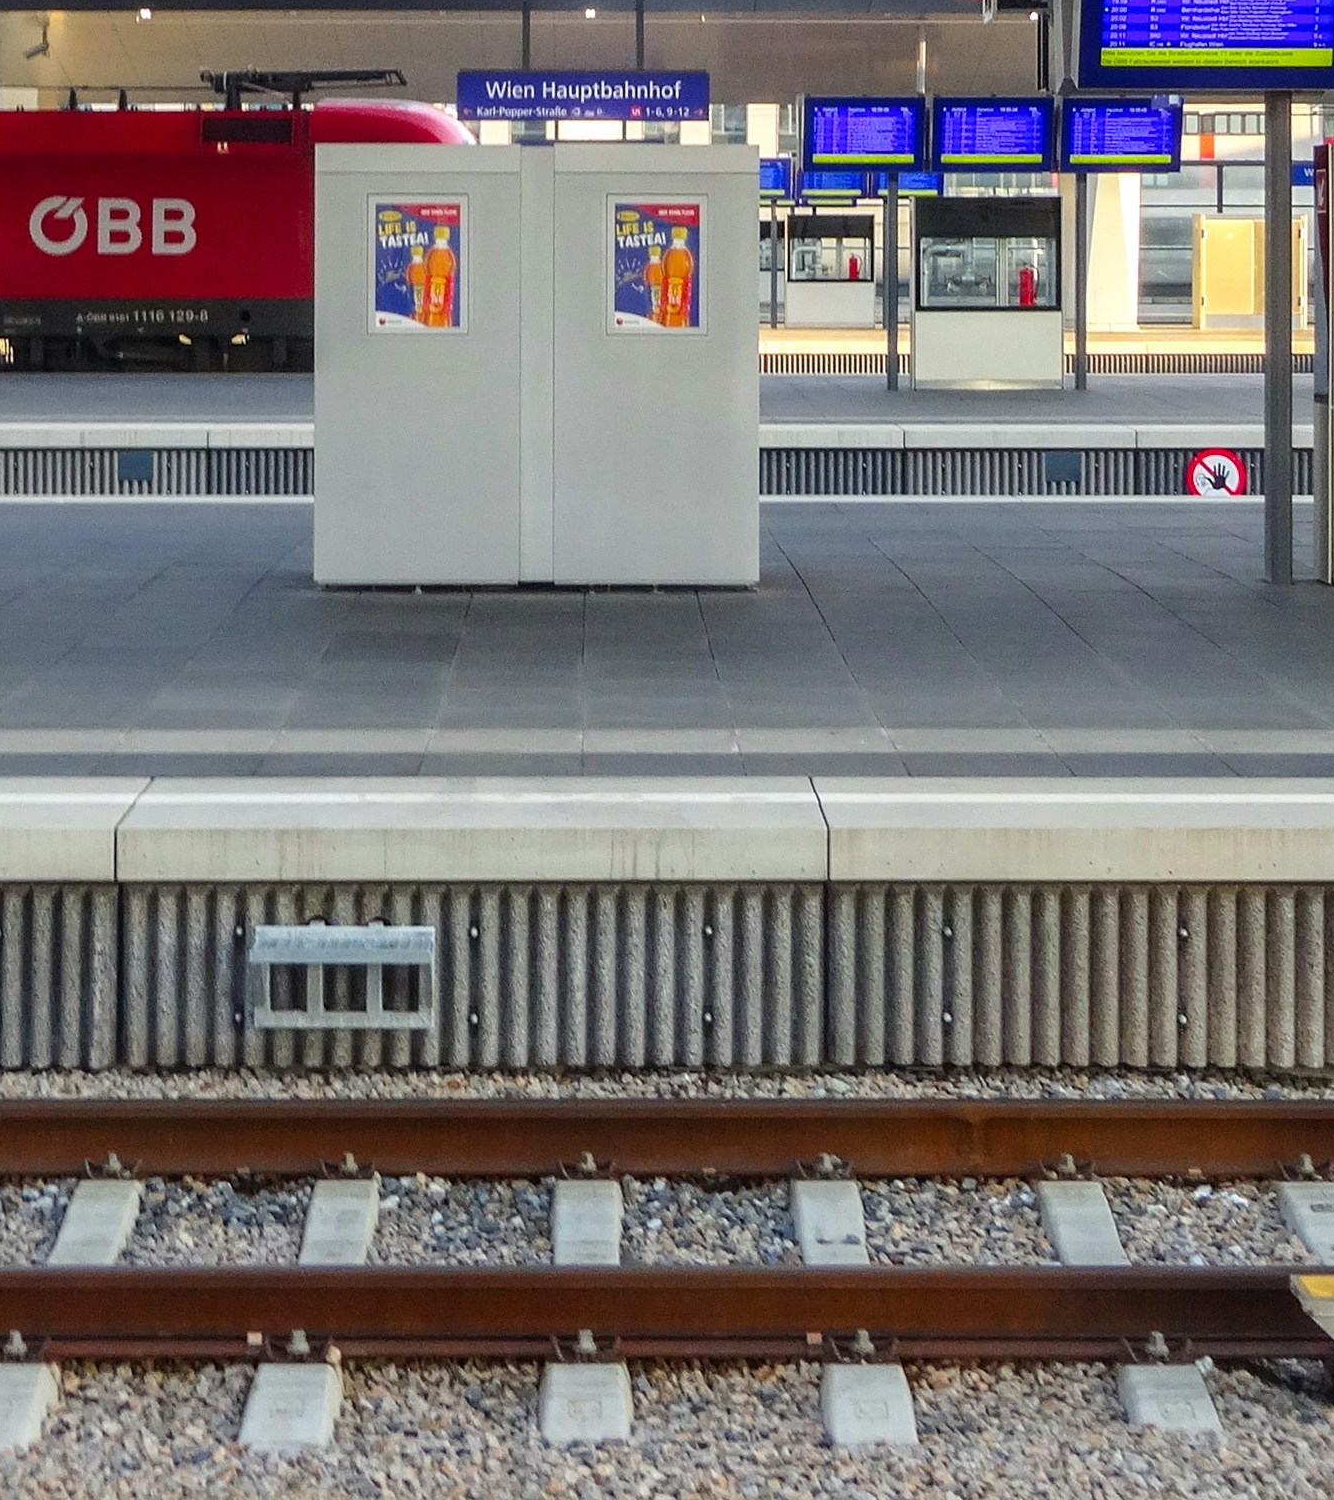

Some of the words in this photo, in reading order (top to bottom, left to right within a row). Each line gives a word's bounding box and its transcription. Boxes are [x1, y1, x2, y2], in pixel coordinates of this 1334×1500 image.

[485, 80, 535, 99] Wien
[542, 80, 682, 103] Hauptbahnhof
[476, 104, 567, 119] Karl-Popper-Straße
[29, 194, 197, 256] ÖBB
[378, 222, 402, 236] LIFE
[406, 221, 417, 234] IS
[616, 222, 639, 236] LIFE
[643, 220, 654, 233] IS
[133, 308, 165, 323] 1116
